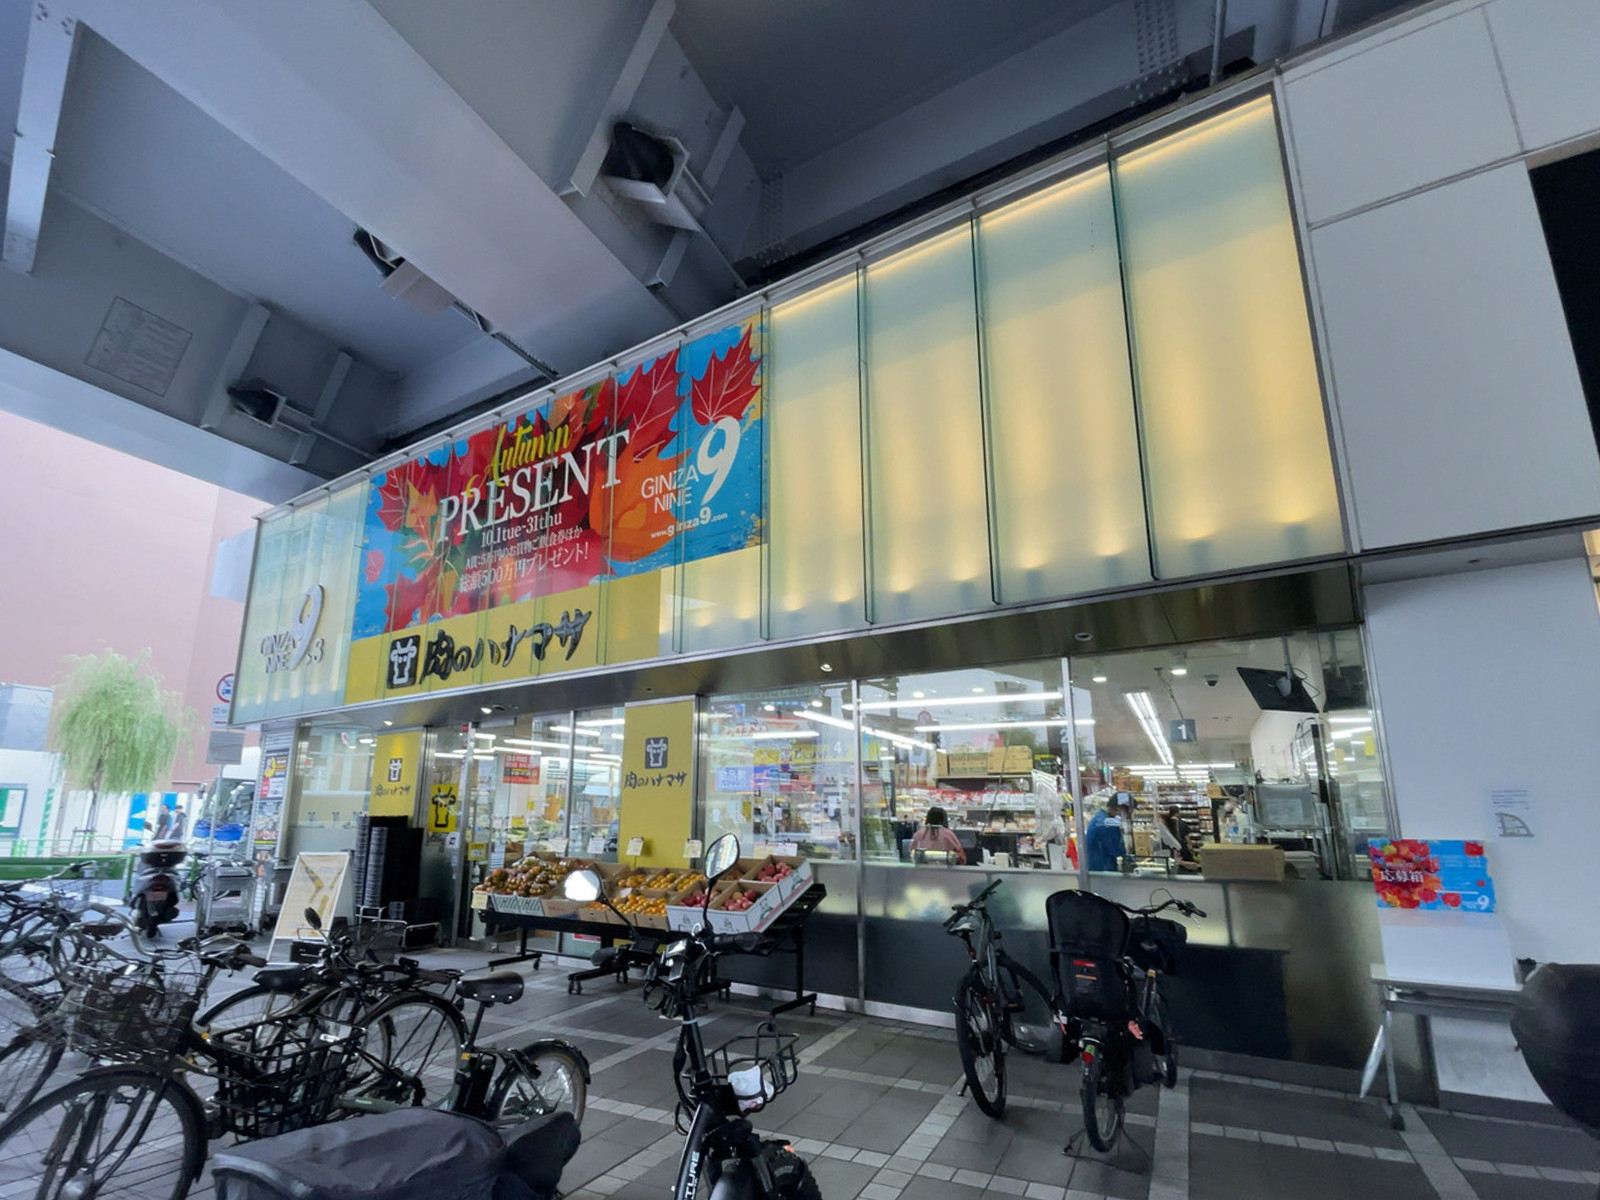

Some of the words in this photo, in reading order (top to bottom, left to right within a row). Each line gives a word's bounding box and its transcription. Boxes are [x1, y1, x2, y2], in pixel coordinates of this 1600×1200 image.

[466, 424, 570, 498] Autumn
[697, 416, 741, 506] 9
[437, 429, 631, 543] PRESENT
[641, 464, 700, 499] GINZA
[654, 486, 693, 514] NINE
[650, 506, 728, 539] www.ginza9.com
[419, 608, 592, 685] 肉のハナマサ
[1177, 724, 1187, 740] 1
[624, 771, 688, 790] 肉のハナマサ
